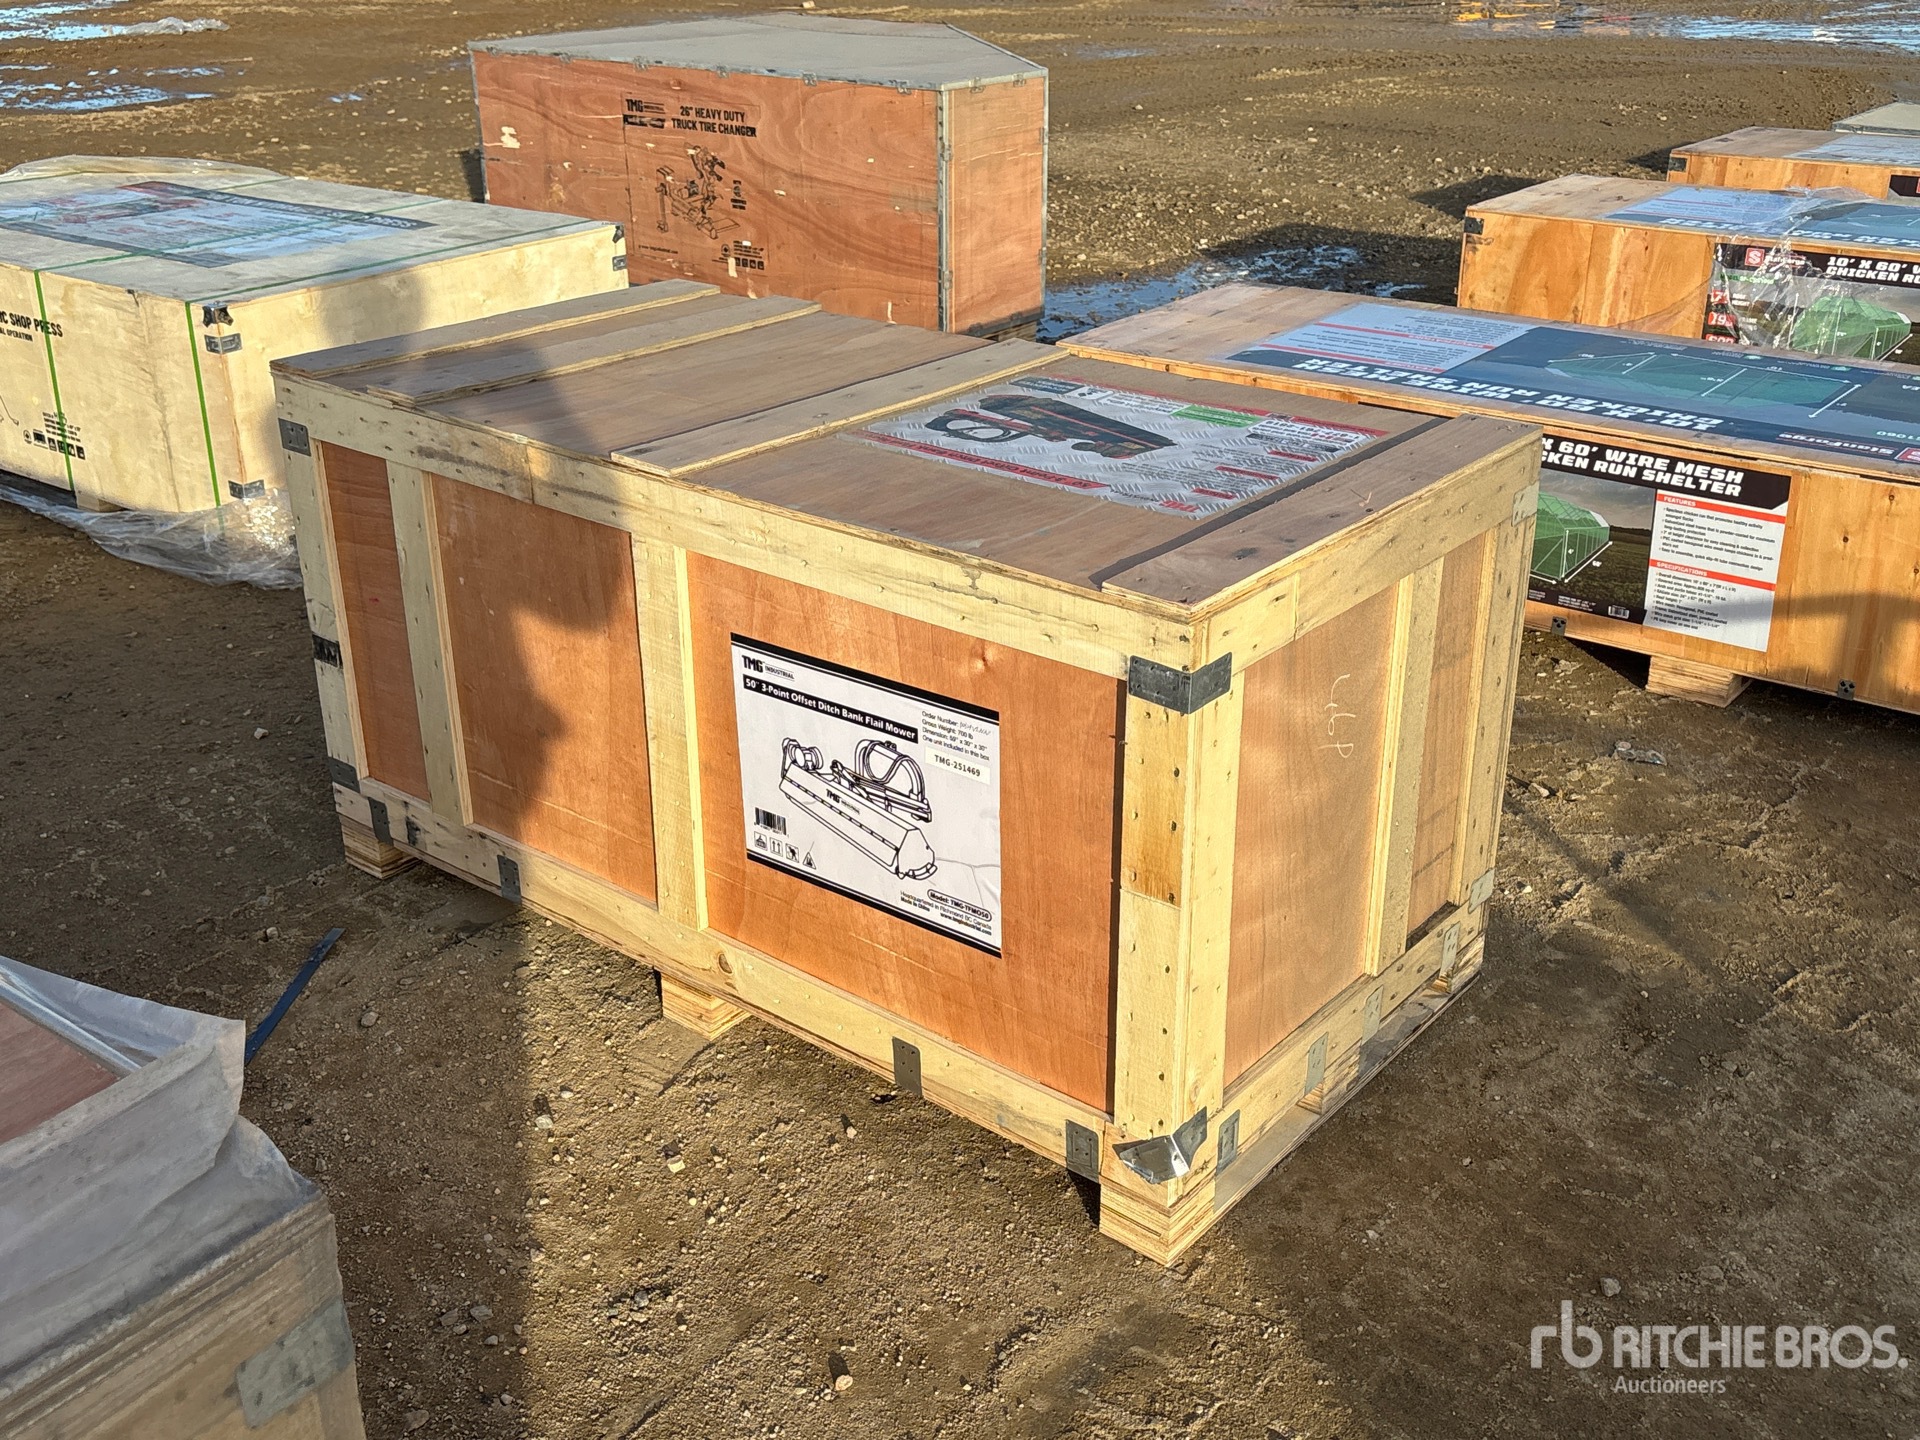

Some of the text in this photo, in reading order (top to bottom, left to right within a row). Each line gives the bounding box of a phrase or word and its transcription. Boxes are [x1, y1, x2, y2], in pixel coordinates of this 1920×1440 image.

[625, 99, 643, 113] TMG
[680, 106, 745, 123] 26" HEAVY DUTY
[671, 118, 698, 131] TRUCK
[699, 120, 717, 133] TIRE
[718, 123, 757, 137] CHANGER
[1827, 257, 1856, 267] 10'
[1859, 260, 1873, 269] X
[1876, 262, 1908, 272] 60'
[1826, 266, 1900, 281] CHICKEN
[9, 313, 32, 330] SHOP
[6, 329, 33, 342] OPERATION
[1292, 358, 1717, 431] 10' X 60' WIRE MESH
[1305, 358, 1724, 425] CHICKEN RUN SHELTER
[1779, 433, 1895, 455] StanForge
[1558, 442, 1599, 457] 60'
[1605, 448, 1671, 472] WIRE
[1674, 461, 1745, 485] MESH
[1593, 459, 1638, 478] RUN
[1641, 469, 1742, 497] SHELTER
[1663, 496, 1696, 507] FEATURES
[1656, 561, 1708, 577] SPECIFICATIONS
[742, 655, 795, 679] TMG INDUSTRIAL
[745, 678, 916, 740] 50" 3-Point Offset Ditch Bank Flail Mower
[922, 711, 936, 720] Order
[922, 719, 937, 729] Gross
[922, 727, 949, 740] Dimension:
[922, 735, 933, 743] One
[944, 742, 964, 753] included
[970, 750, 979, 758] this
[980, 753, 990, 761] box
[934, 754, 981, 777] TMG-251469
[826, 788, 840, 804] TMG
[901, 896, 912, 905] Made
[918, 903, 930, 912] China
[930, 892, 949, 904] Model:
[940, 905, 964, 919] Richmond
[973, 918, 992, 930] Canada
